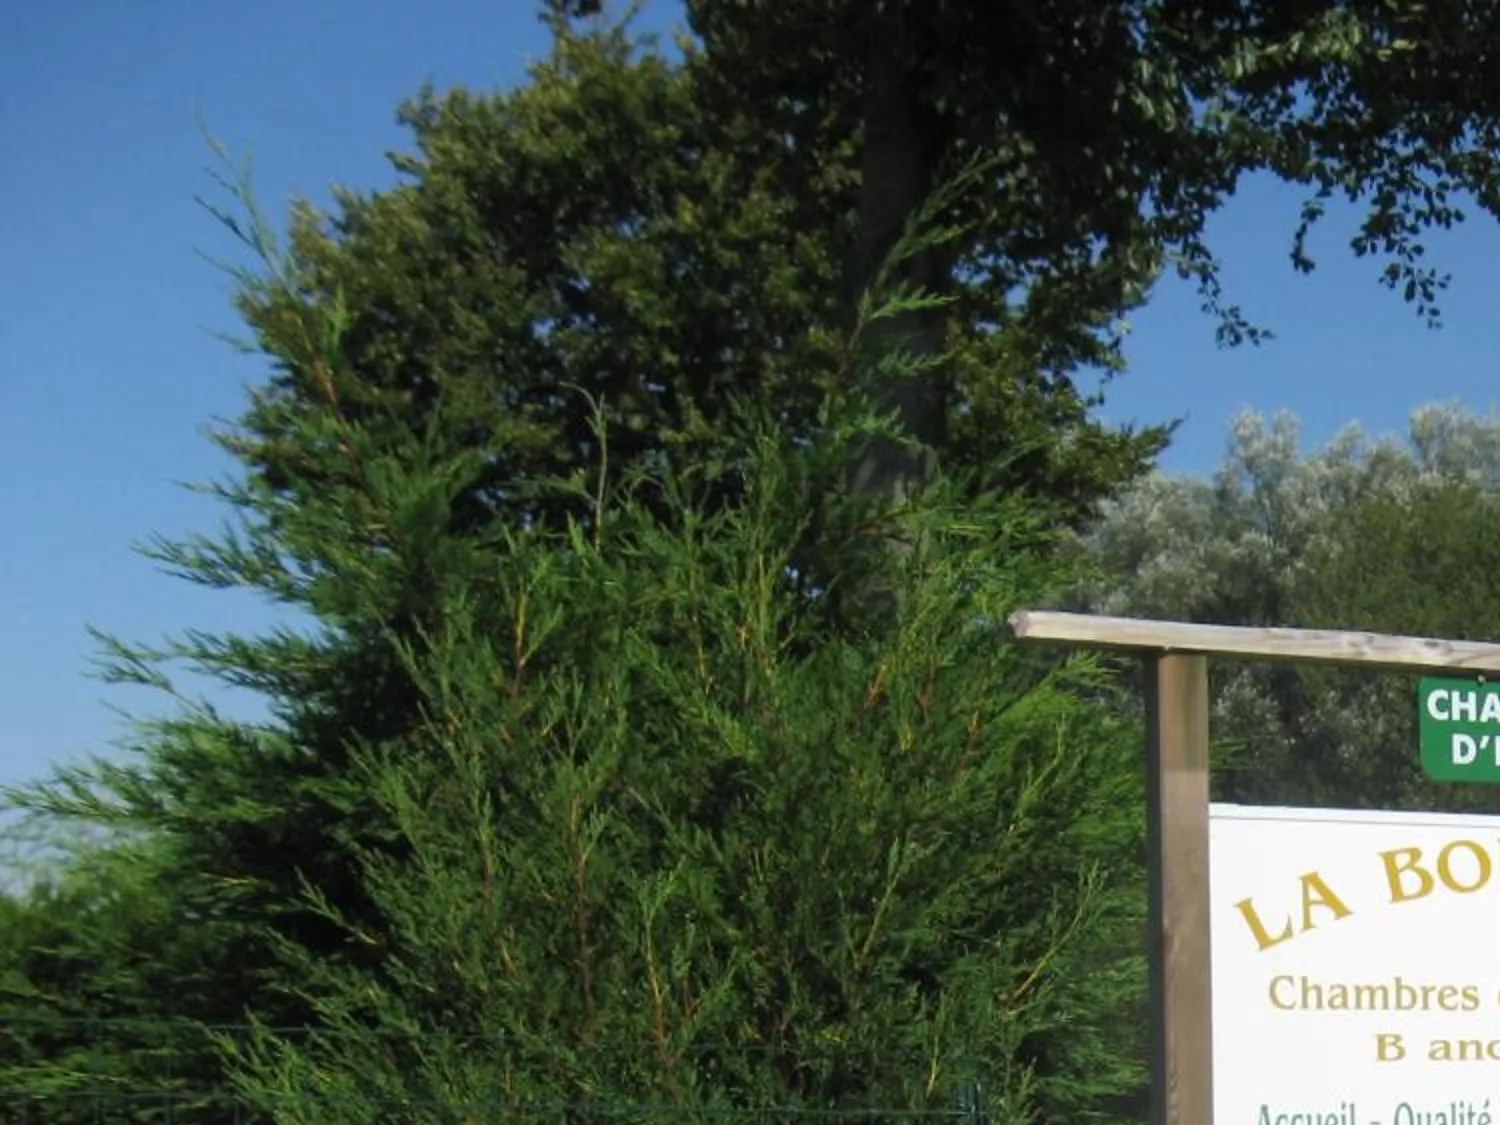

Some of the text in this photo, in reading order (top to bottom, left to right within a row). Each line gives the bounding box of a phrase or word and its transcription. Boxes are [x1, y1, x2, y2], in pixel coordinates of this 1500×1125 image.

[1235, 871, 1353, 951] LA
[1268, 975, 1480, 1011] Chambres
[1376, 1034, 1406, 1061] B
